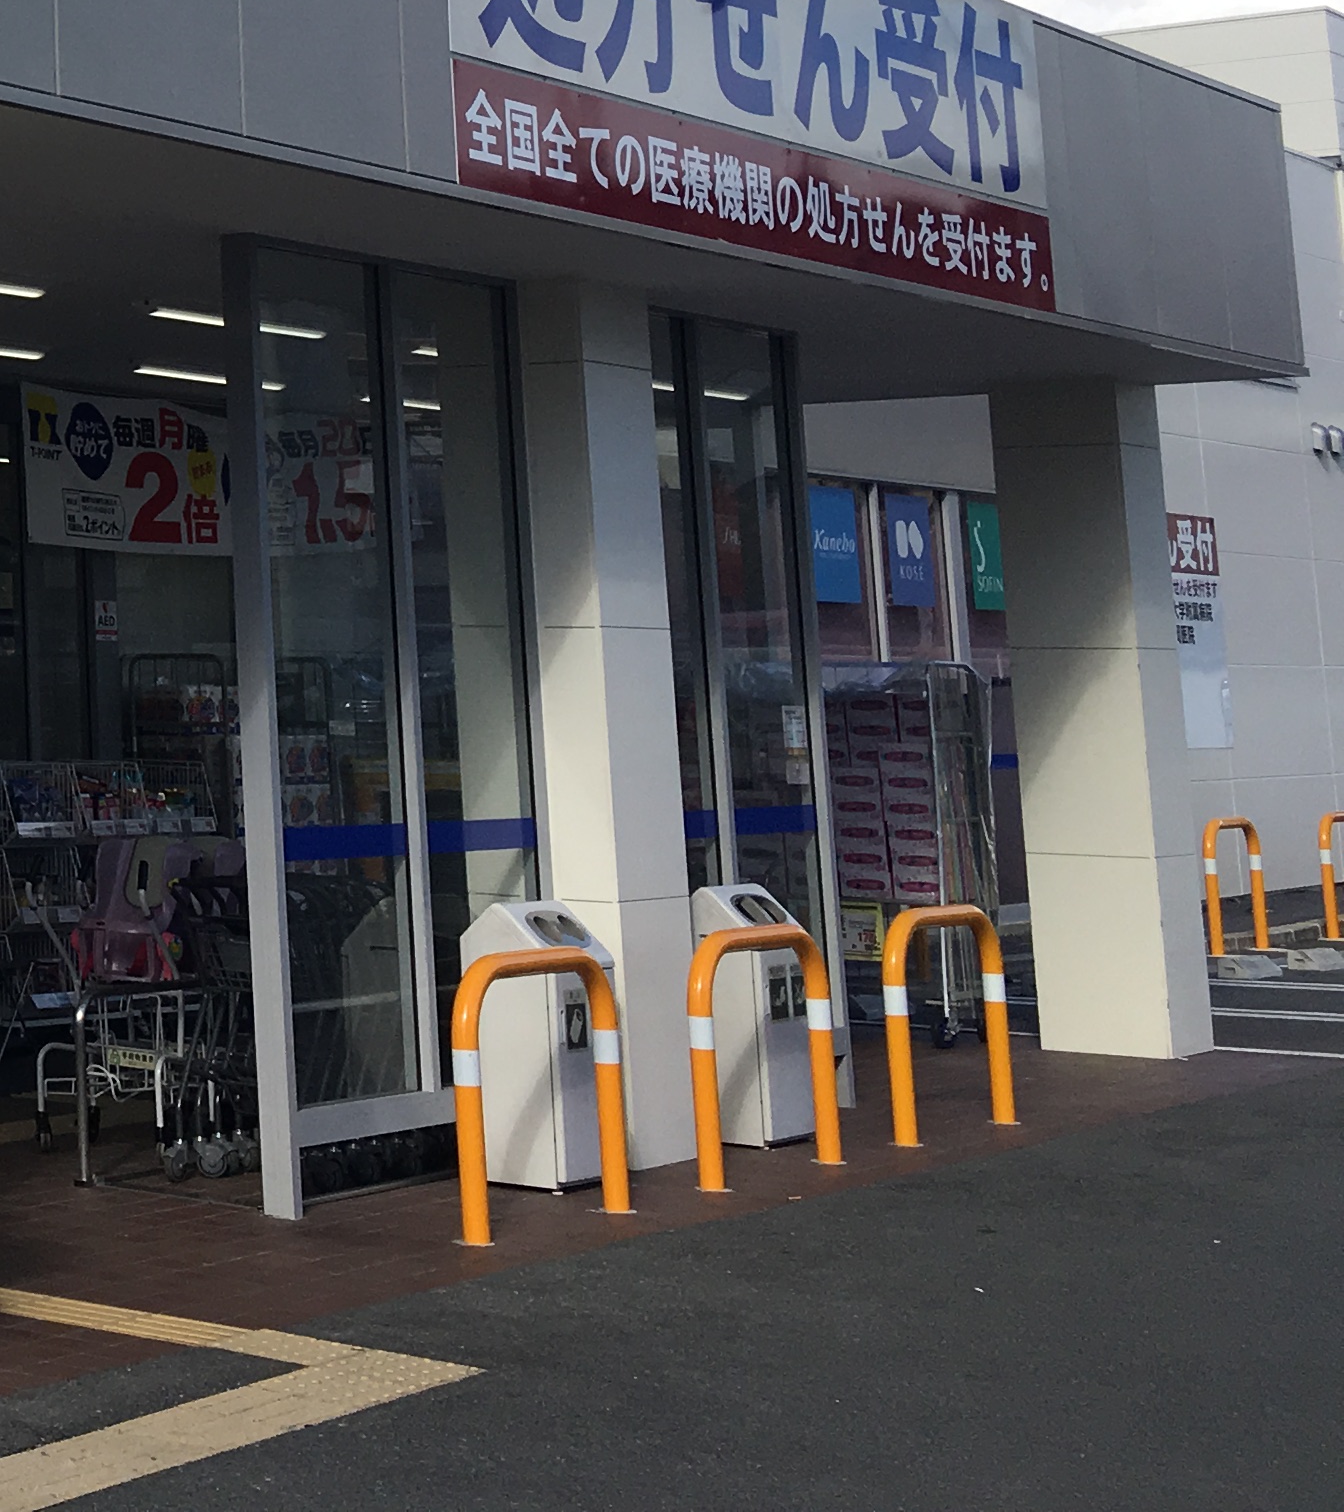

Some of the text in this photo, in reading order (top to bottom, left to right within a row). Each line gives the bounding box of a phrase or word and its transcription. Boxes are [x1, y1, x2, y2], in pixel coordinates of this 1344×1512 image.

[465, 88, 1050, 292] 全国全ての医療機関の処方せんを受付ます。
[814, 528, 855, 553] Kanebo
[98, 615, 116, 627] AED
